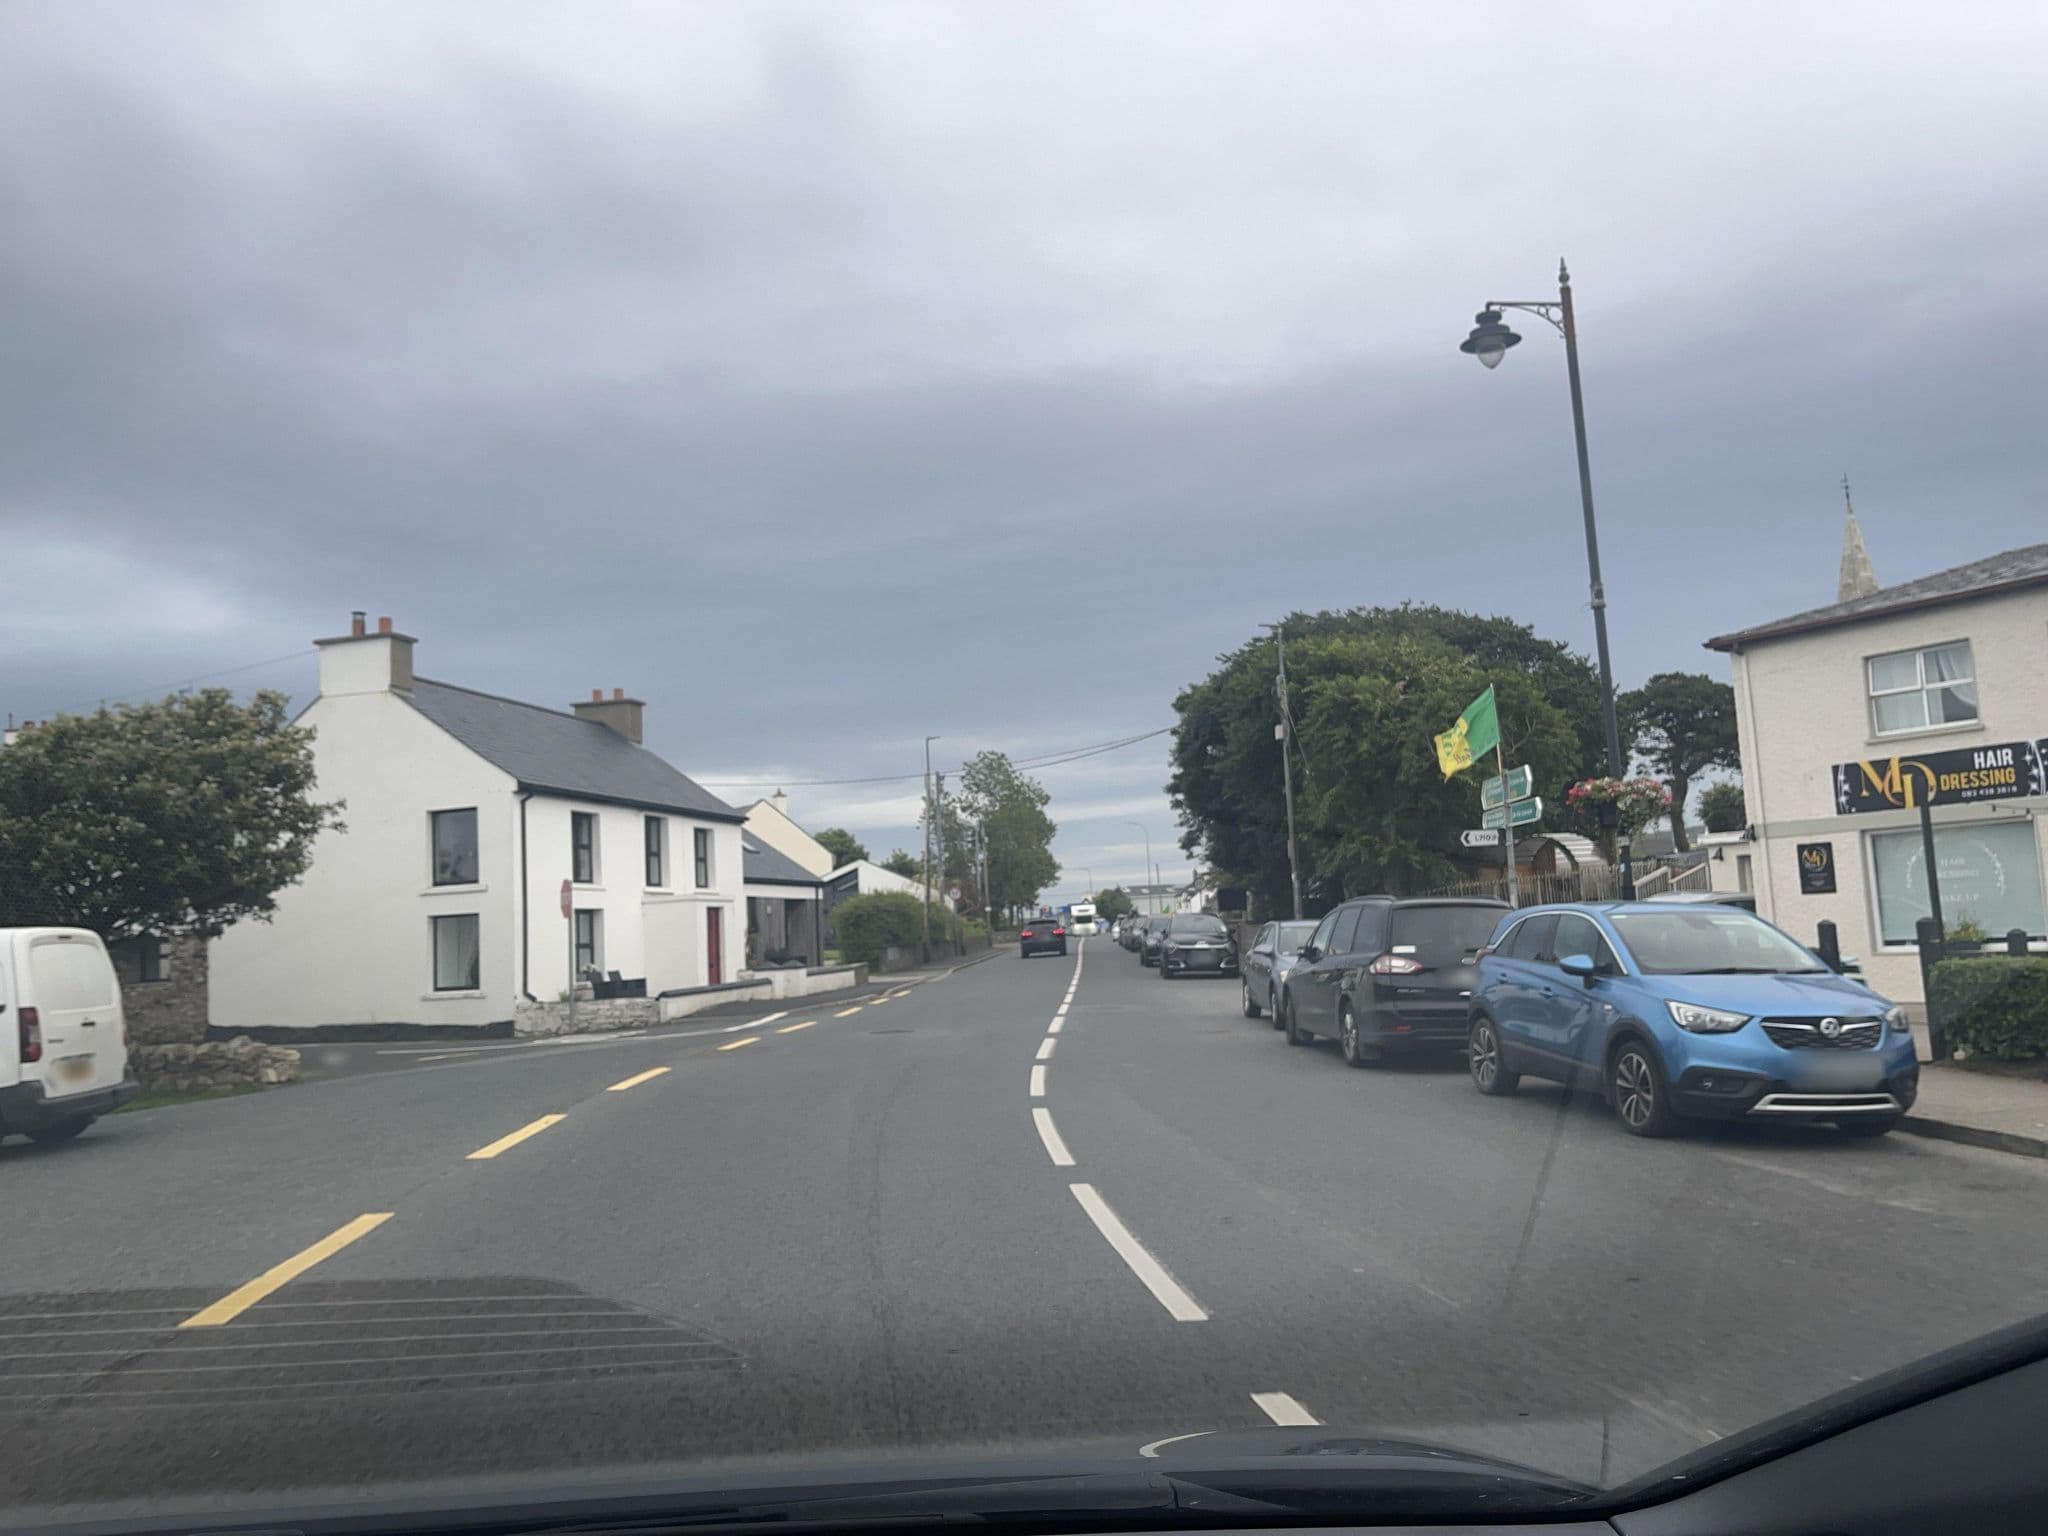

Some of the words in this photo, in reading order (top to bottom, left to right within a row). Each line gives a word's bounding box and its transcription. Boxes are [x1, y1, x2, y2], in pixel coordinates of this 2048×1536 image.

[1973, 748, 2014, 769] HAIR
[1858, 756, 1937, 810] MD
[1940, 767, 2016, 791] DRESSING
